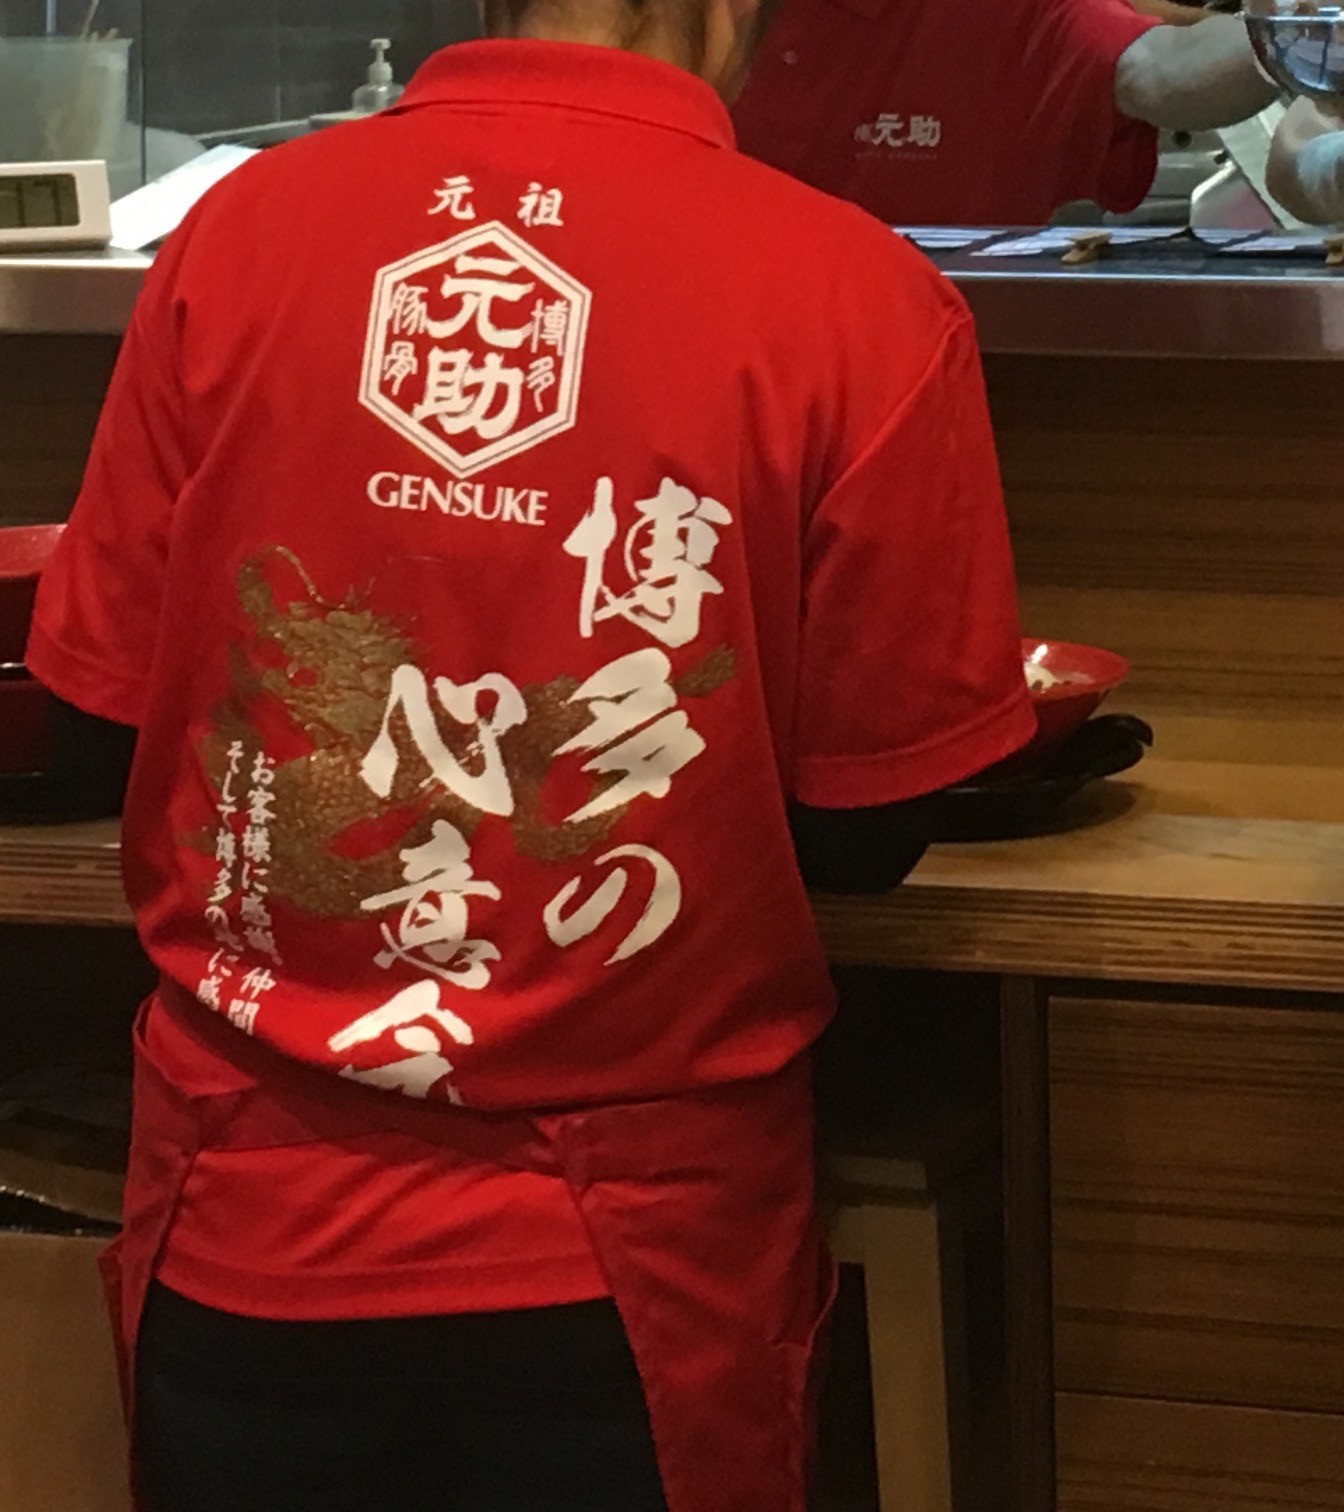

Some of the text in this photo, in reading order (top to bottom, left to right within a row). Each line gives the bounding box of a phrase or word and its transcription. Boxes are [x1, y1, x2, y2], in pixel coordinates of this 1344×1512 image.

[427, 174, 565, 228] 元祖
[412, 253, 536, 439] 元助
[365, 470, 549, 527] GENSUKE
[542, 475, 734, 968] 博多の
